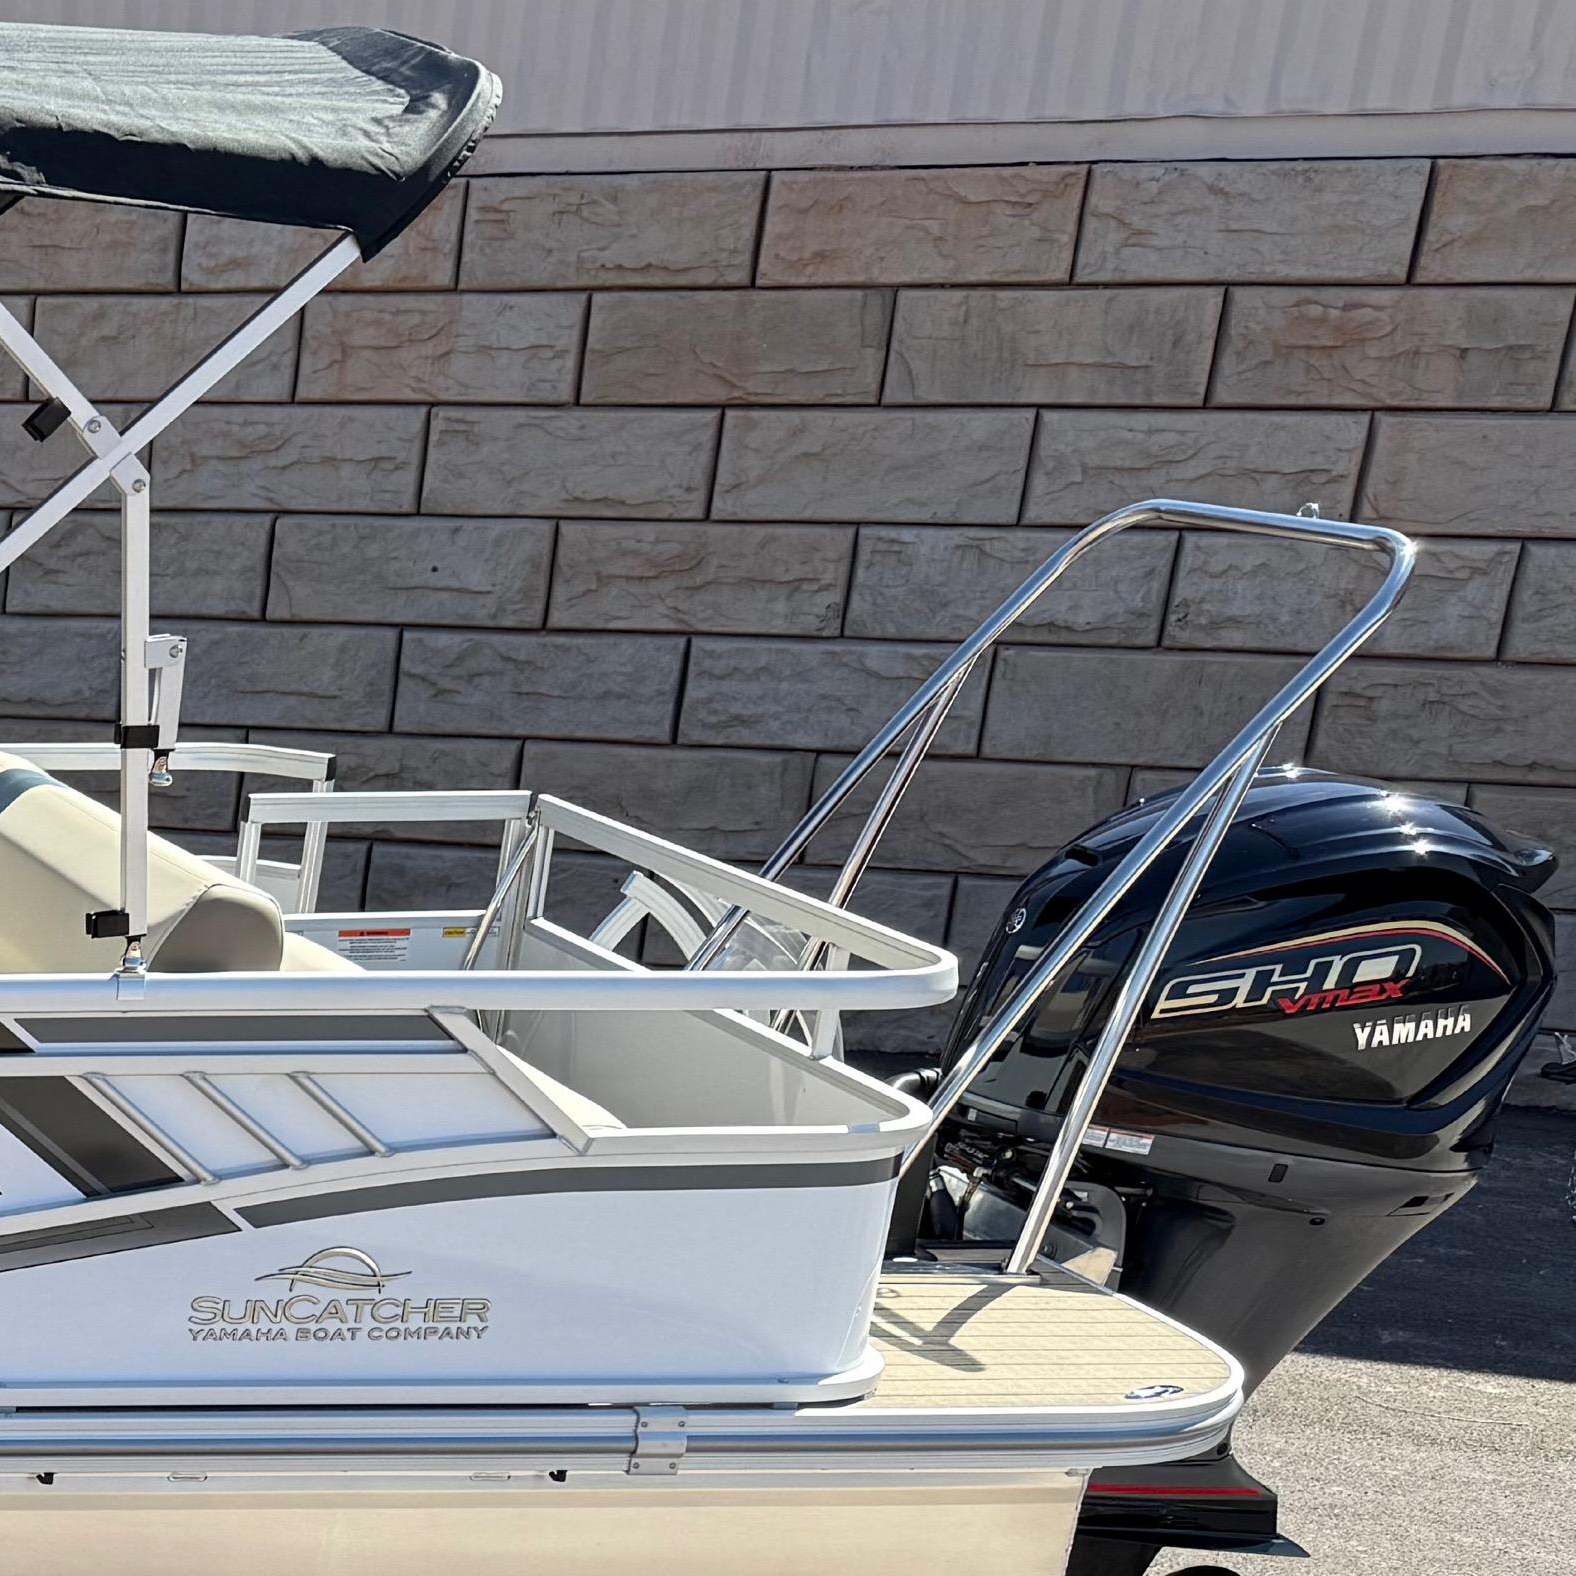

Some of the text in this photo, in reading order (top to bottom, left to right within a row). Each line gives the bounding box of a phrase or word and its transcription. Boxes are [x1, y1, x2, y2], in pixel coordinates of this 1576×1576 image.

[1151, 943, 1422, 1019] SHO
[1353, 1004, 1472, 1051] YAMAHA
[188, 1325, 490, 1342] YAMAHA BOAT COMPANY
